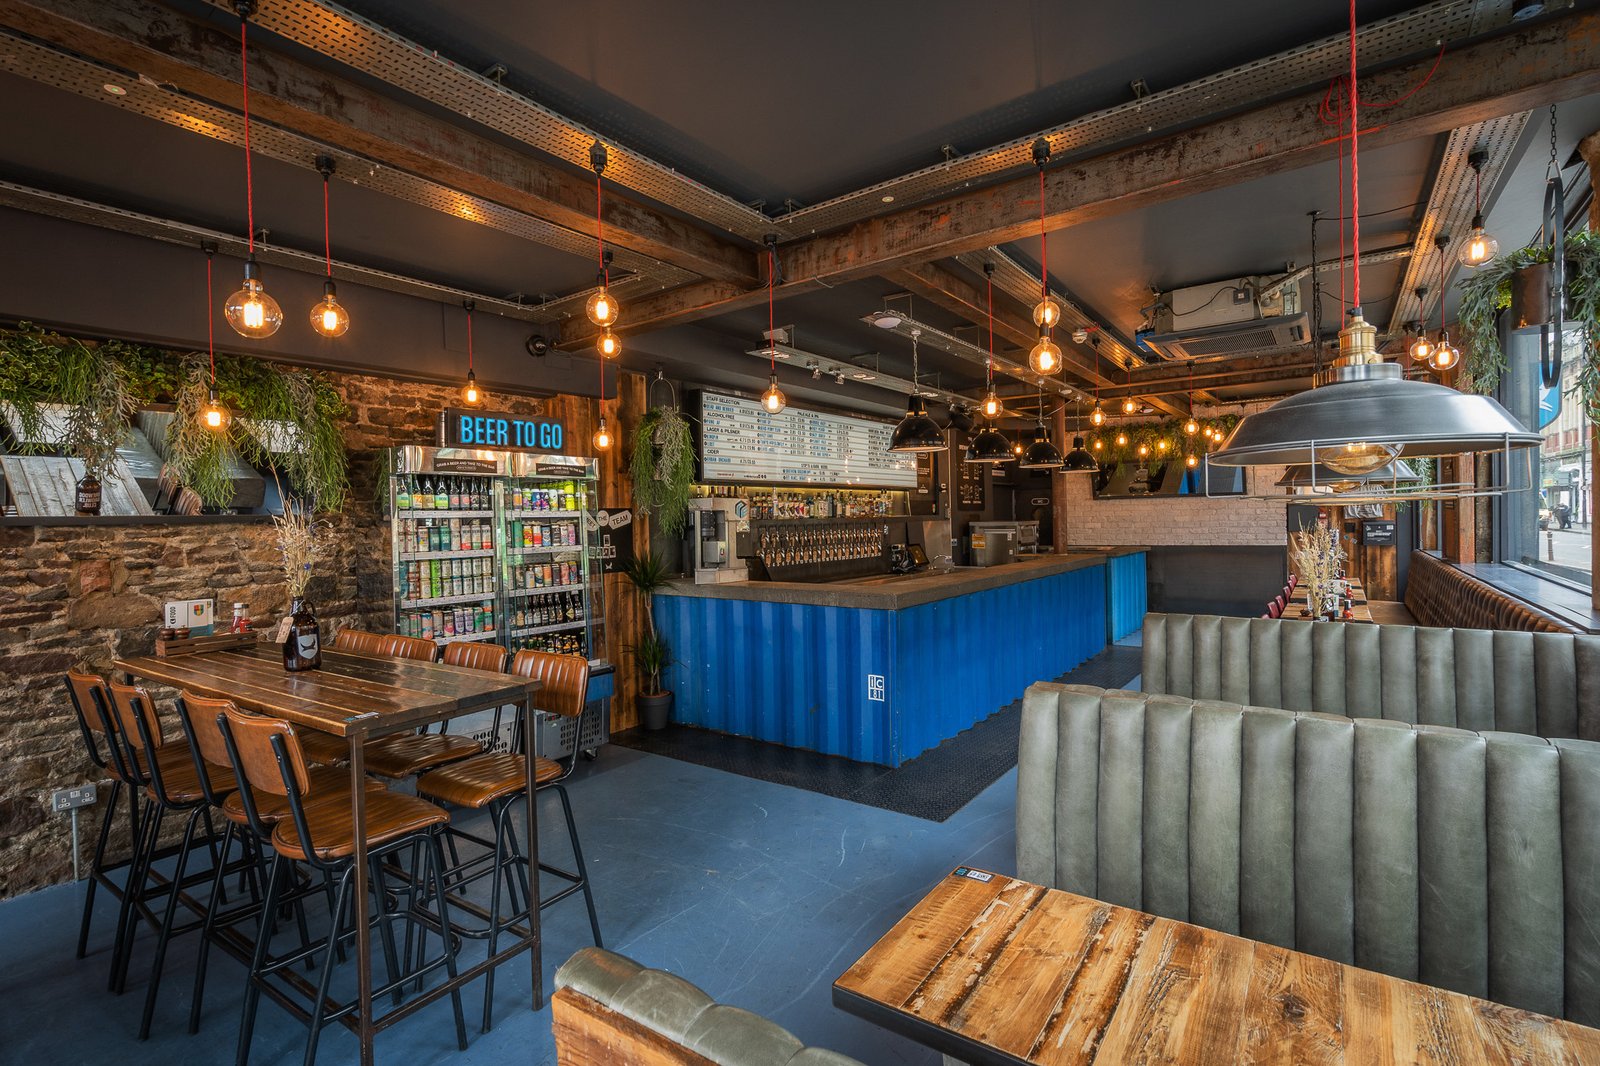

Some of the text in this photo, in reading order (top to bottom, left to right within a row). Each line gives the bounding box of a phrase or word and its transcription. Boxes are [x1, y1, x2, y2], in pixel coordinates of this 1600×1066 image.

[461, 415, 562, 449] BEER TO GO
[612, 515, 628, 526] TEAM
